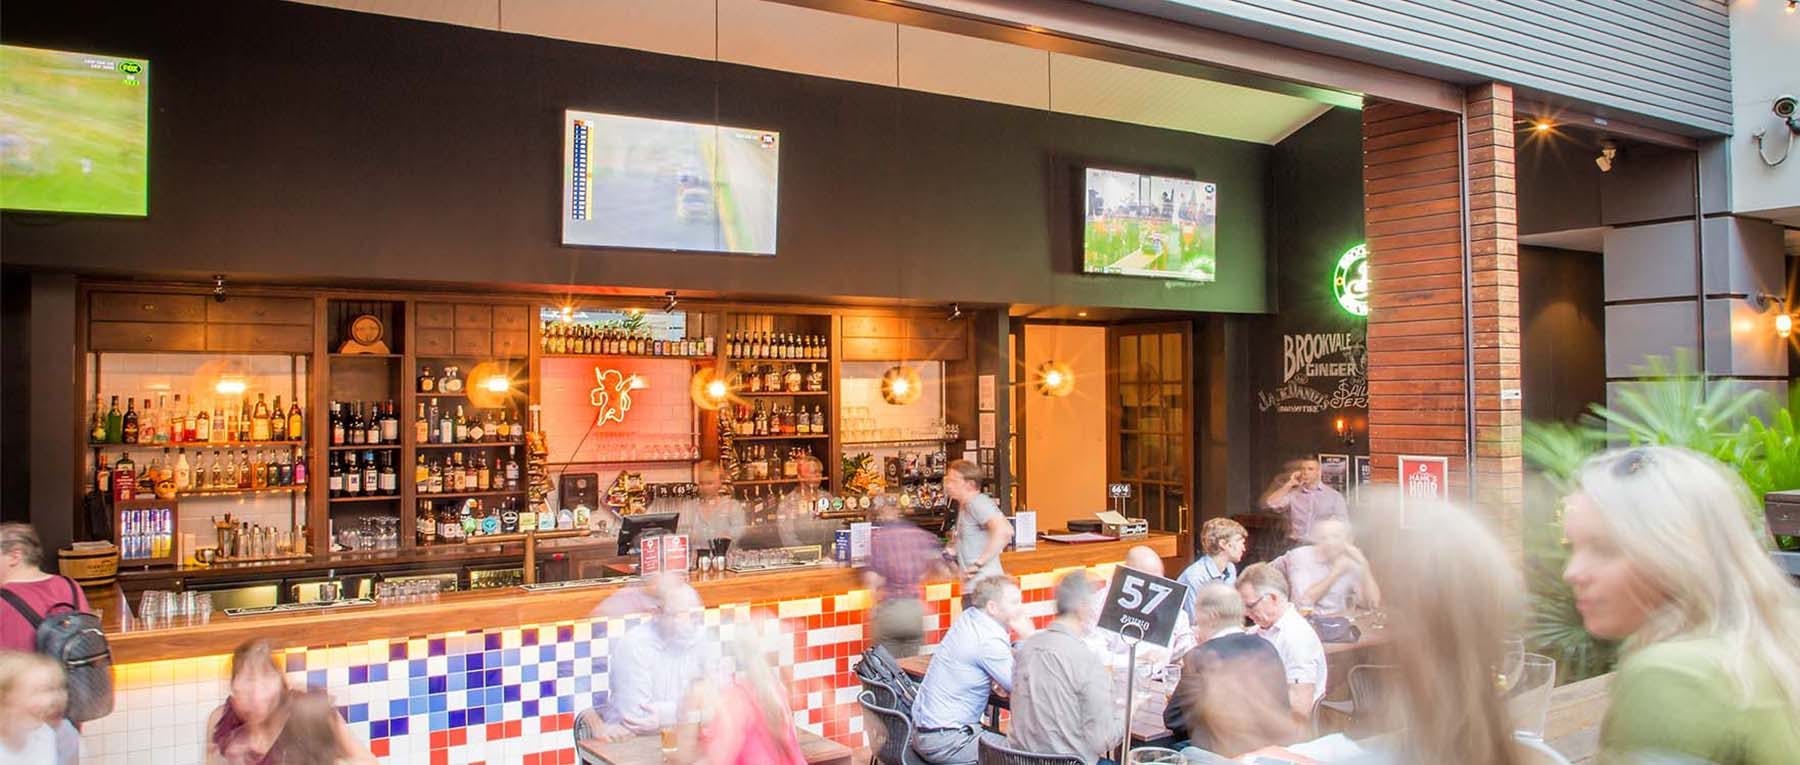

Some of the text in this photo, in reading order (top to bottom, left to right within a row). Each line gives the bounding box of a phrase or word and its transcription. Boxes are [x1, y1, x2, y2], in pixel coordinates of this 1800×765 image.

[122, 64, 138, 72] FOX
[1283, 333, 1352, 383] BROOKVALE
[1306, 363, 1357, 377] GINGER
[1333, 381, 1369, 400] SAIL
[1117, 574, 1173, 615] 57
